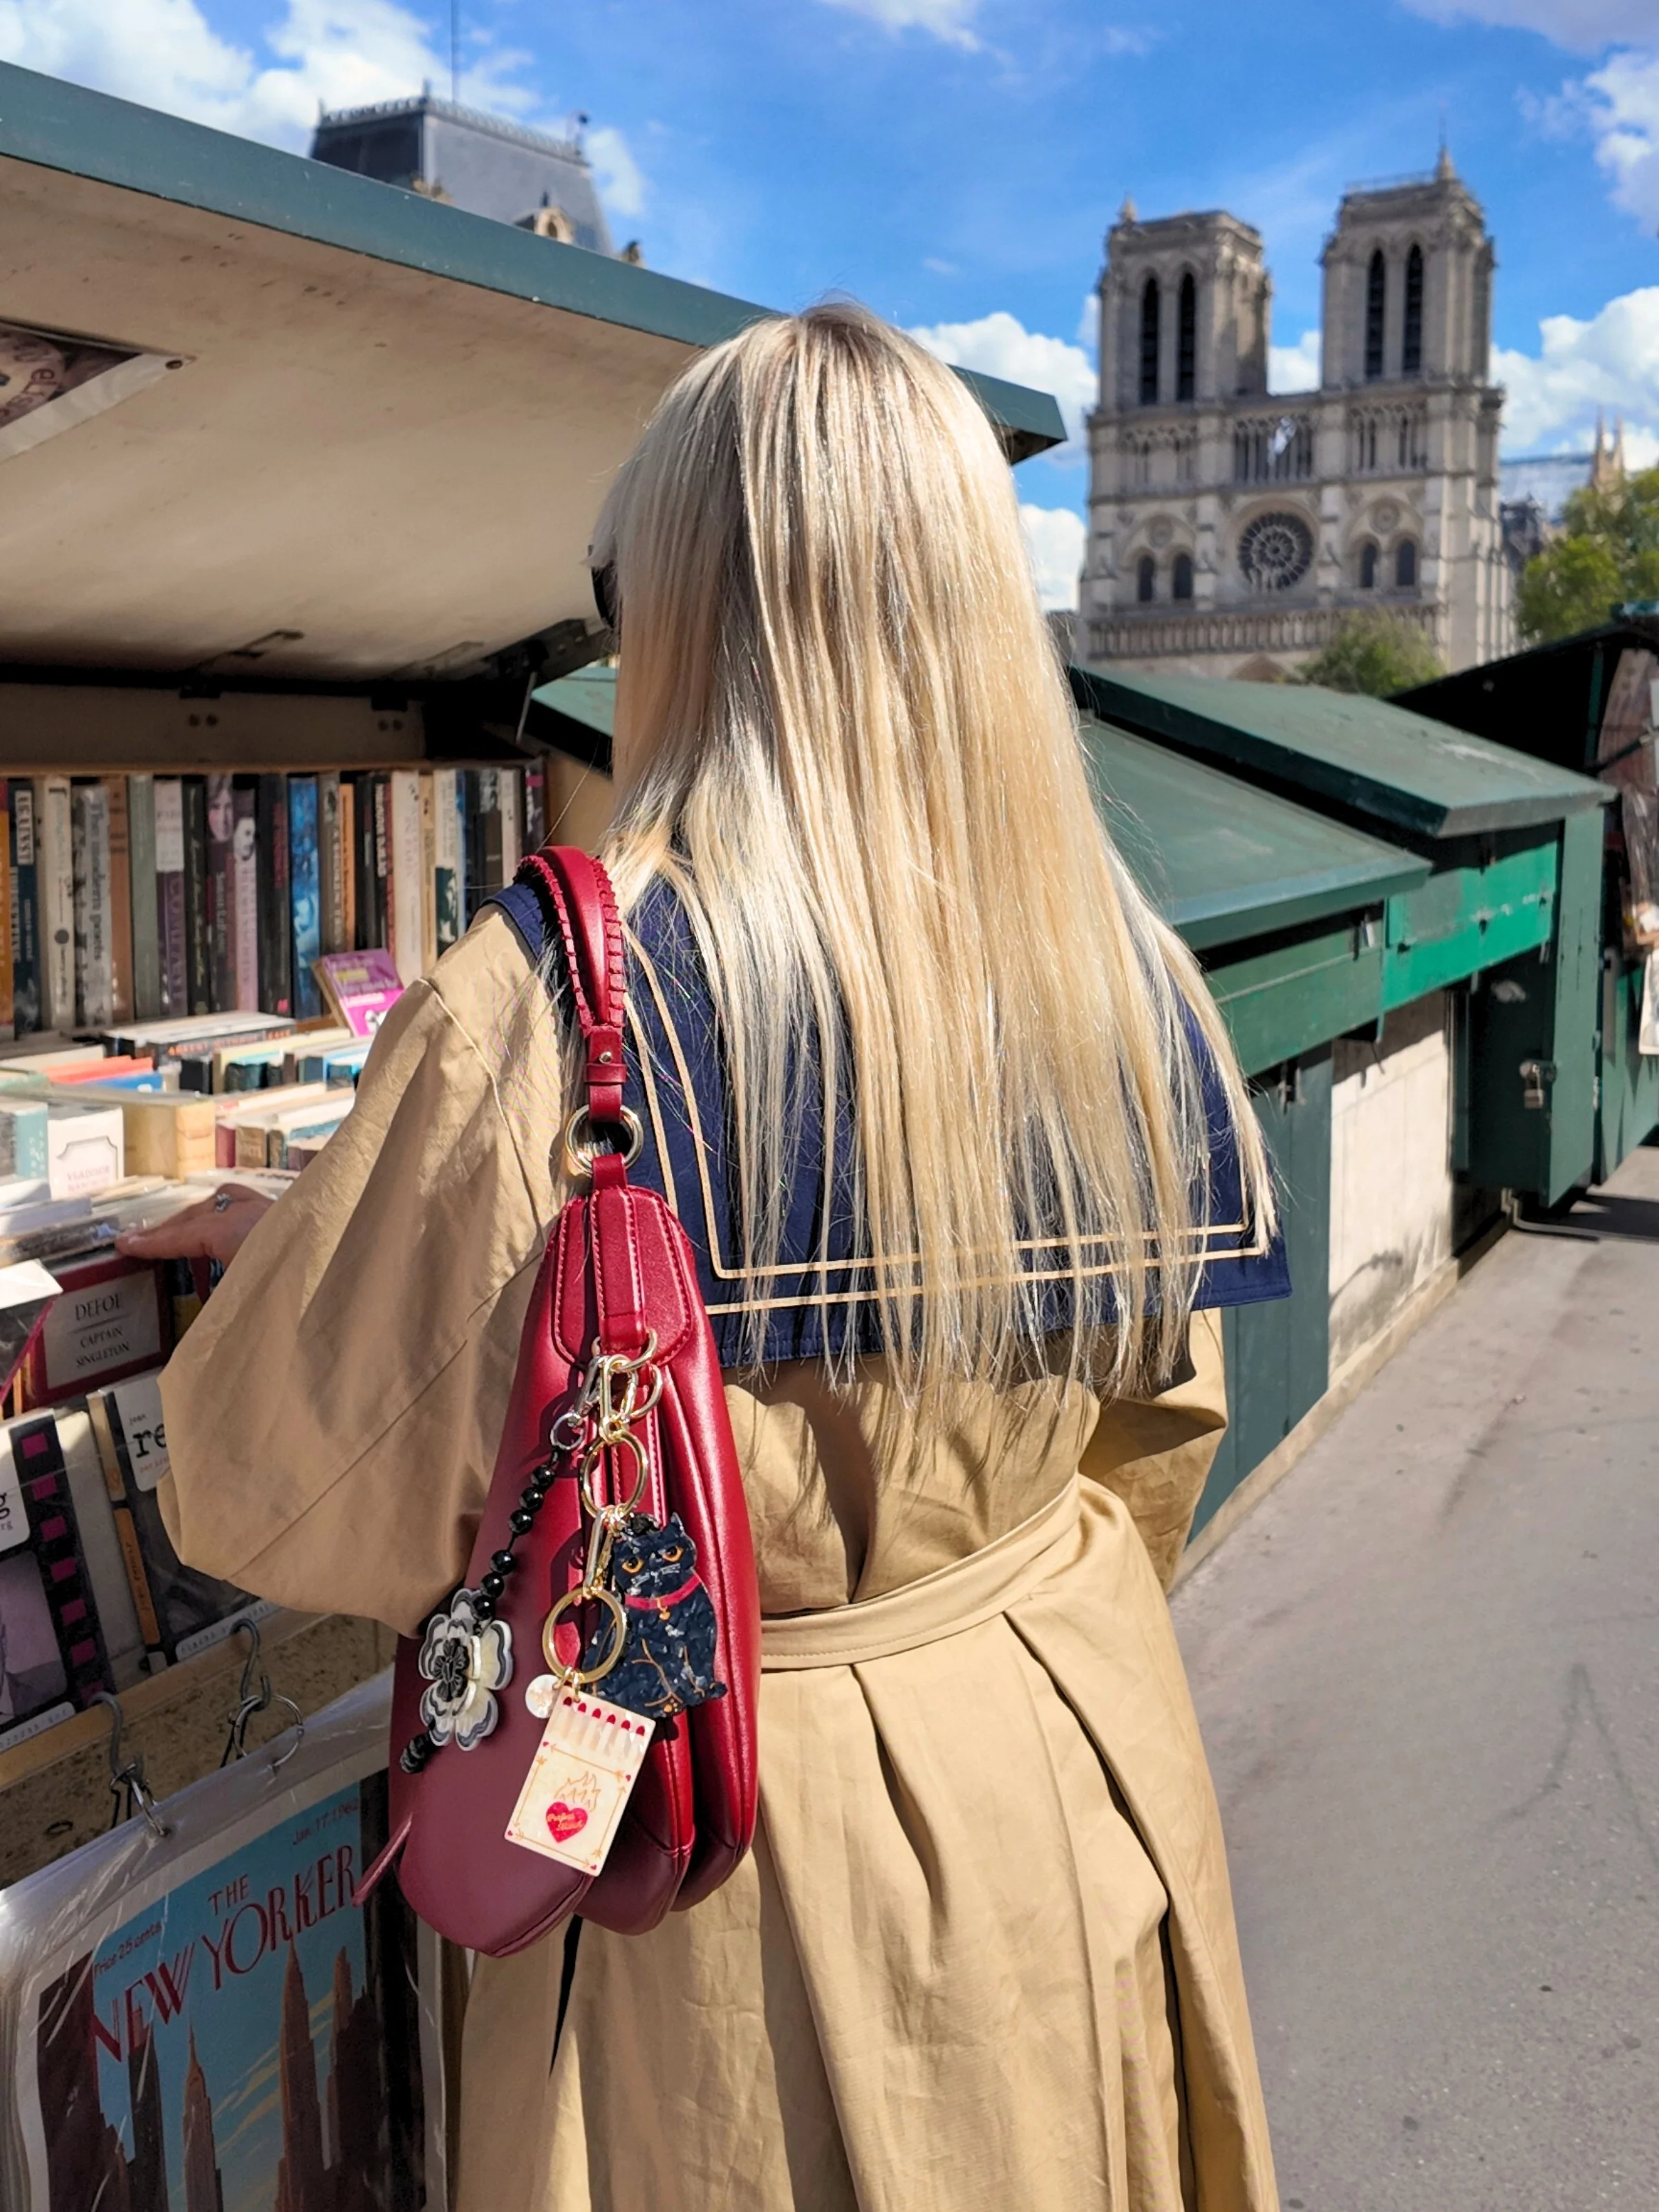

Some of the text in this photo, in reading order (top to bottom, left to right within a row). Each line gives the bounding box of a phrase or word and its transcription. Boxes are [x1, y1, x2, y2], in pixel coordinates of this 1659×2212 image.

[89, 914, 104, 962] poets
[74, 1291, 123, 1322] DEFOE
[79, 1324, 123, 1349] CAPTAIN
[75, 1340, 131, 1368] SINGLETON
[208, 1874, 250, 1917] THE
[93, 1845, 356, 2063] NEW YORKER
[119, 1936, 133, 1960] 25
